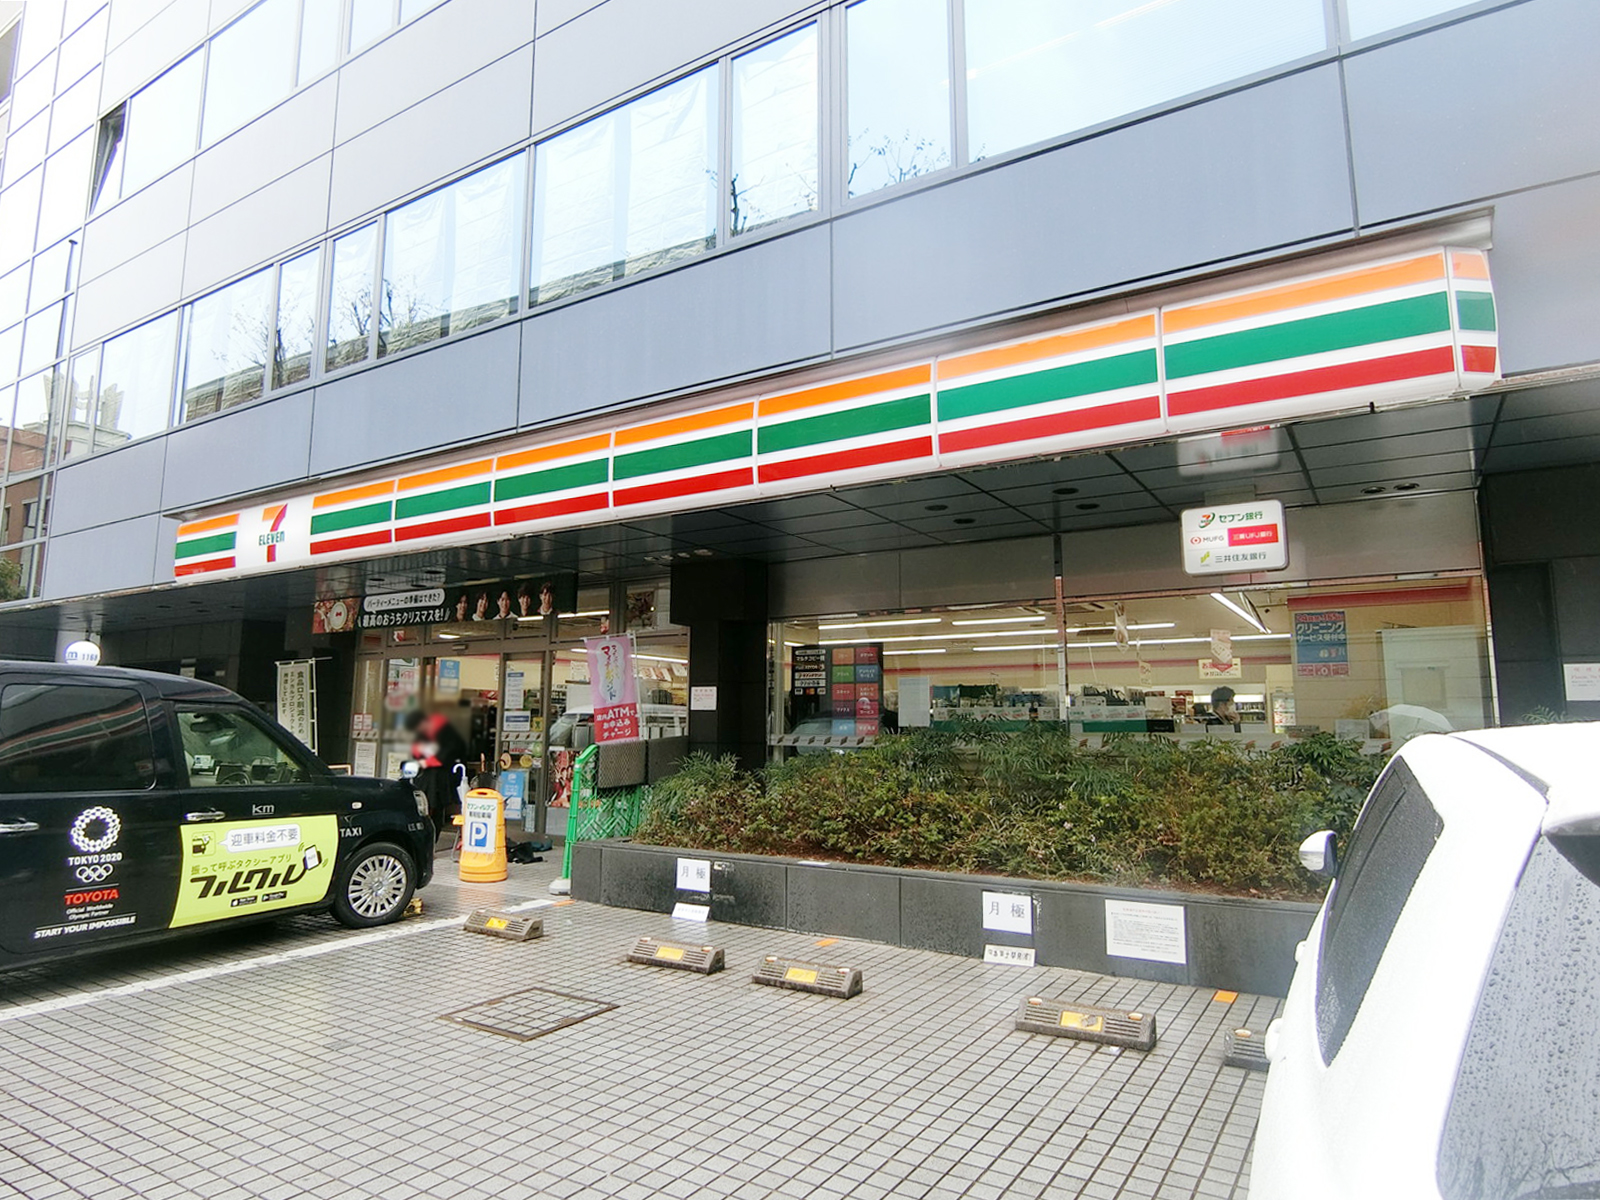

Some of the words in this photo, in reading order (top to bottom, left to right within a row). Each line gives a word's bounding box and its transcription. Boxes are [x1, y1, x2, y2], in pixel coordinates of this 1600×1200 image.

[1219, 511, 1263, 523] セブン銀行
[262, 503, 288, 562] 7
[1215, 552, 1267, 563] 三井住友銀行
[1296, 621, 1344, 634] クリーニング
[1297, 634, 1346, 643] サービス受付中
[252, 804, 275, 814] km
[230, 827, 299, 847] 迎車料金不要
[339, 826, 363, 838] TAXI
[471, 822, 487, 846] P
[68, 855, 99, 866] TOKYO
[100, 852, 123, 863] 2020
[191, 854, 292, 875] 振って呼ぶタクシーアプリ
[190, 864, 307, 899] フルクル
[64, 889, 120, 905] TOYOTA
[66, 906, 85, 915] Official
[86, 902, 114, 912] Worldwide
[68, 912, 90, 921] Olympic
[91, 909, 110, 917] Partner
[34, 927, 62, 939] START
[64, 923, 88, 934] YOUR
[89, 915, 137, 930] IMPOSSIBLE
